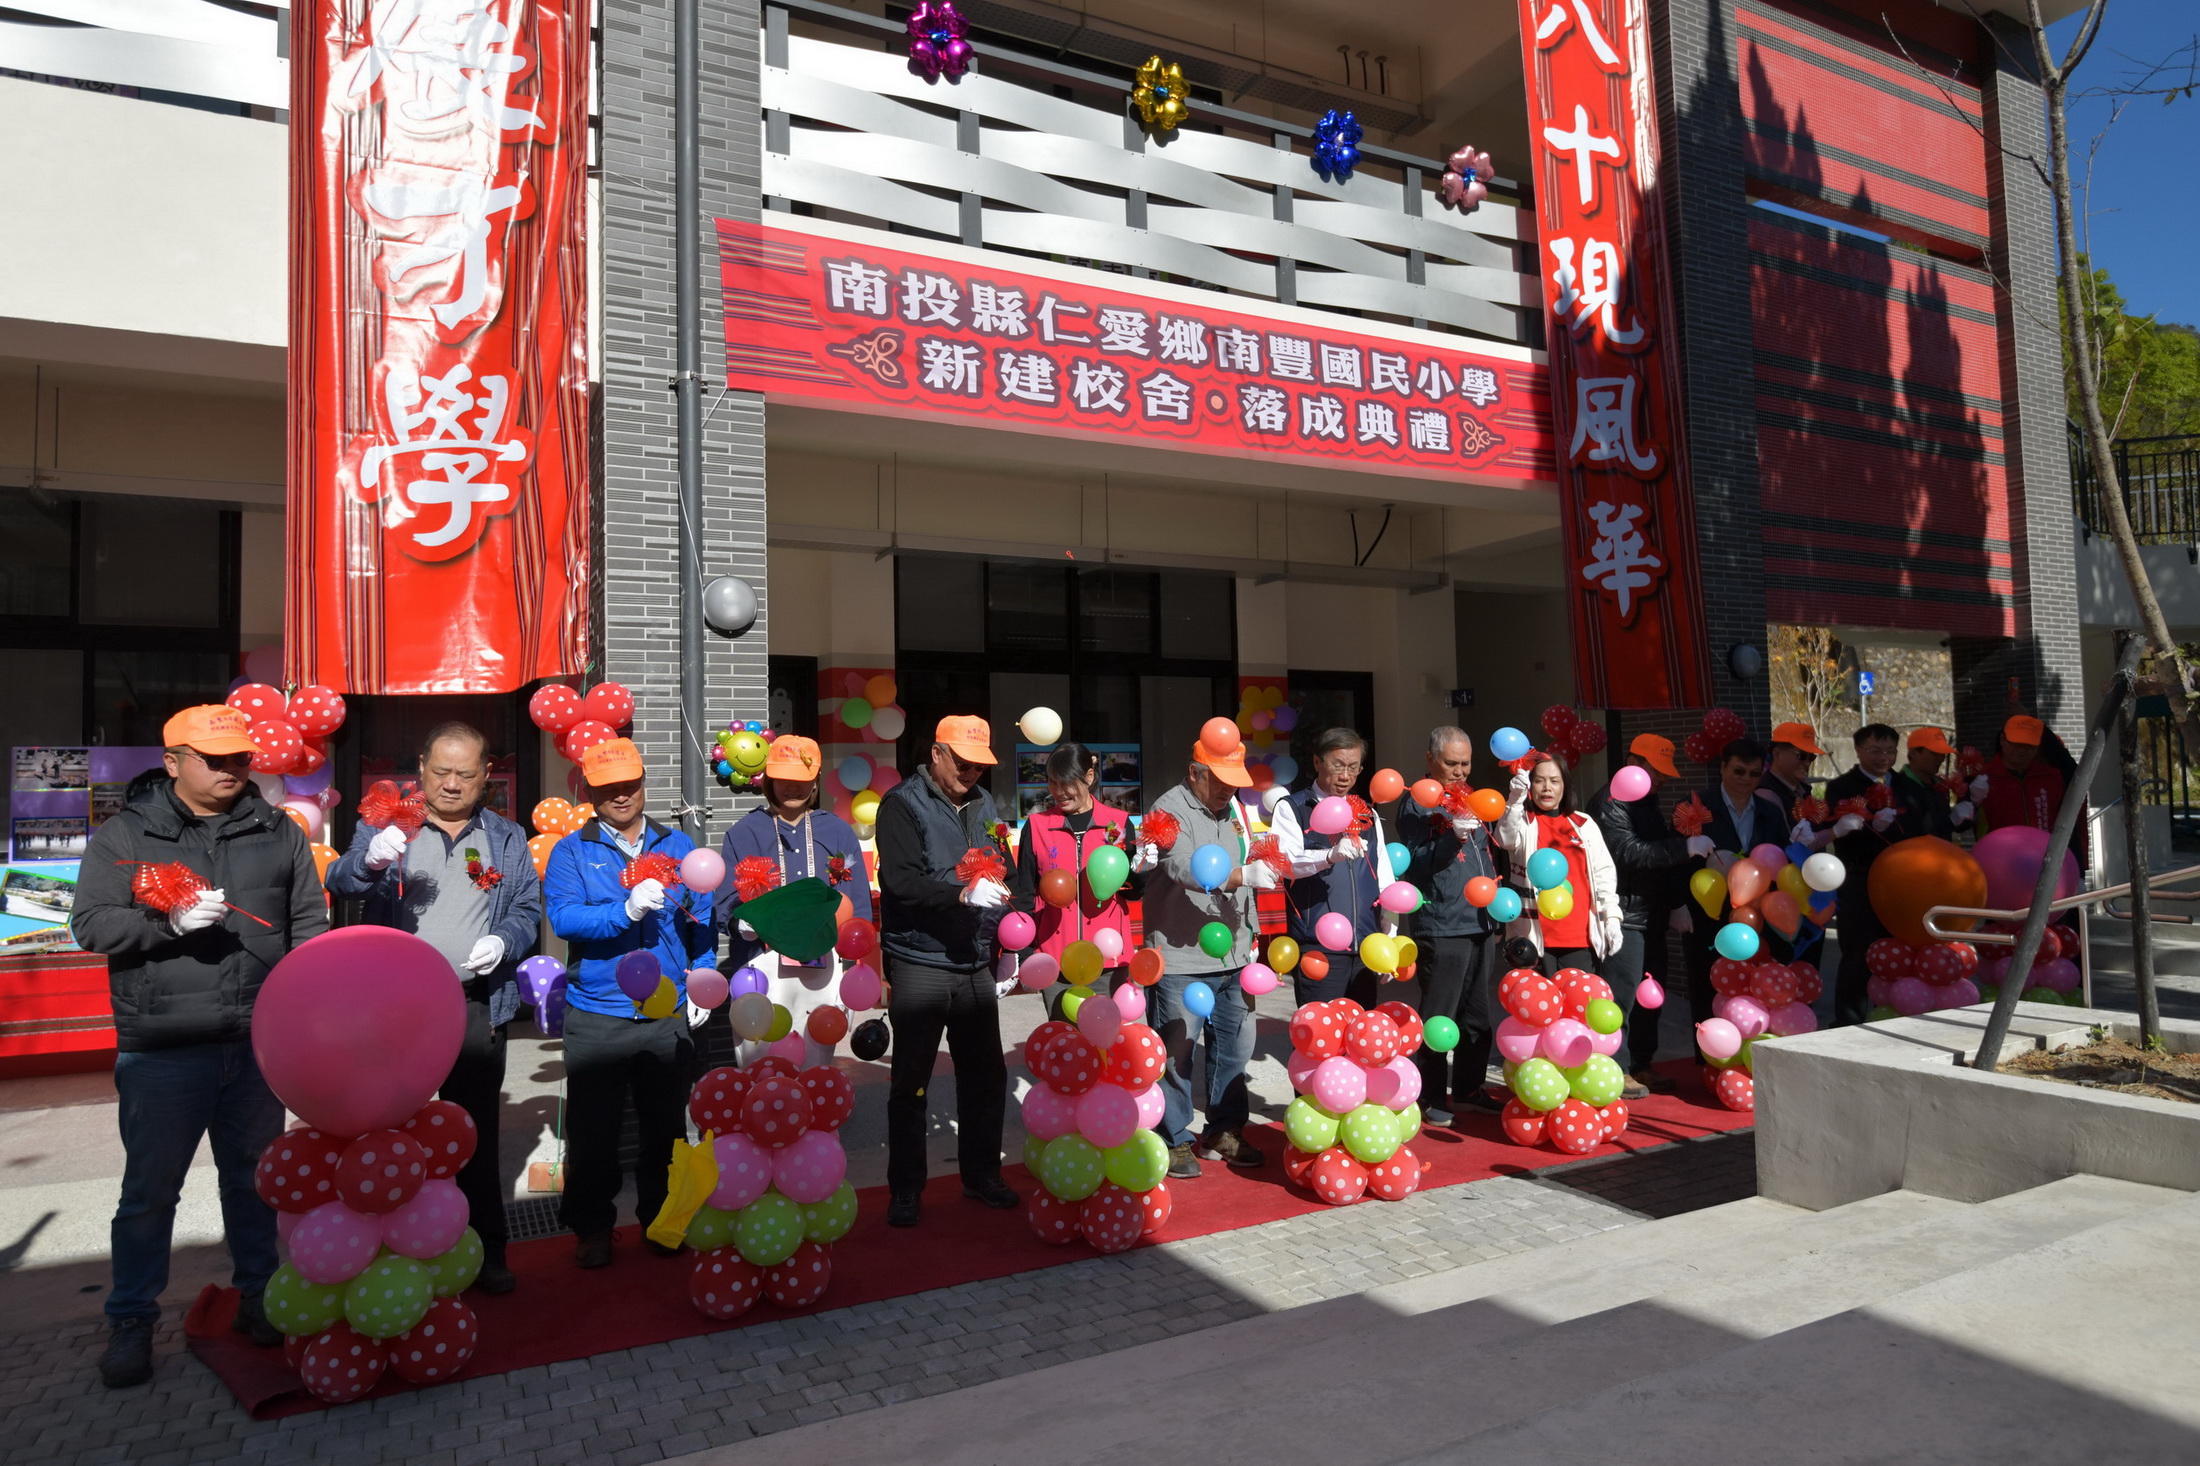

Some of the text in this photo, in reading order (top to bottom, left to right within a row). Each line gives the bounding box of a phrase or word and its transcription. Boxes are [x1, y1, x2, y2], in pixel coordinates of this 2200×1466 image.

[825, 257, 1500, 408] 南投縣仁愛鄉南豐國民小學
[1536, 0, 1662, 618] 八十現風華
